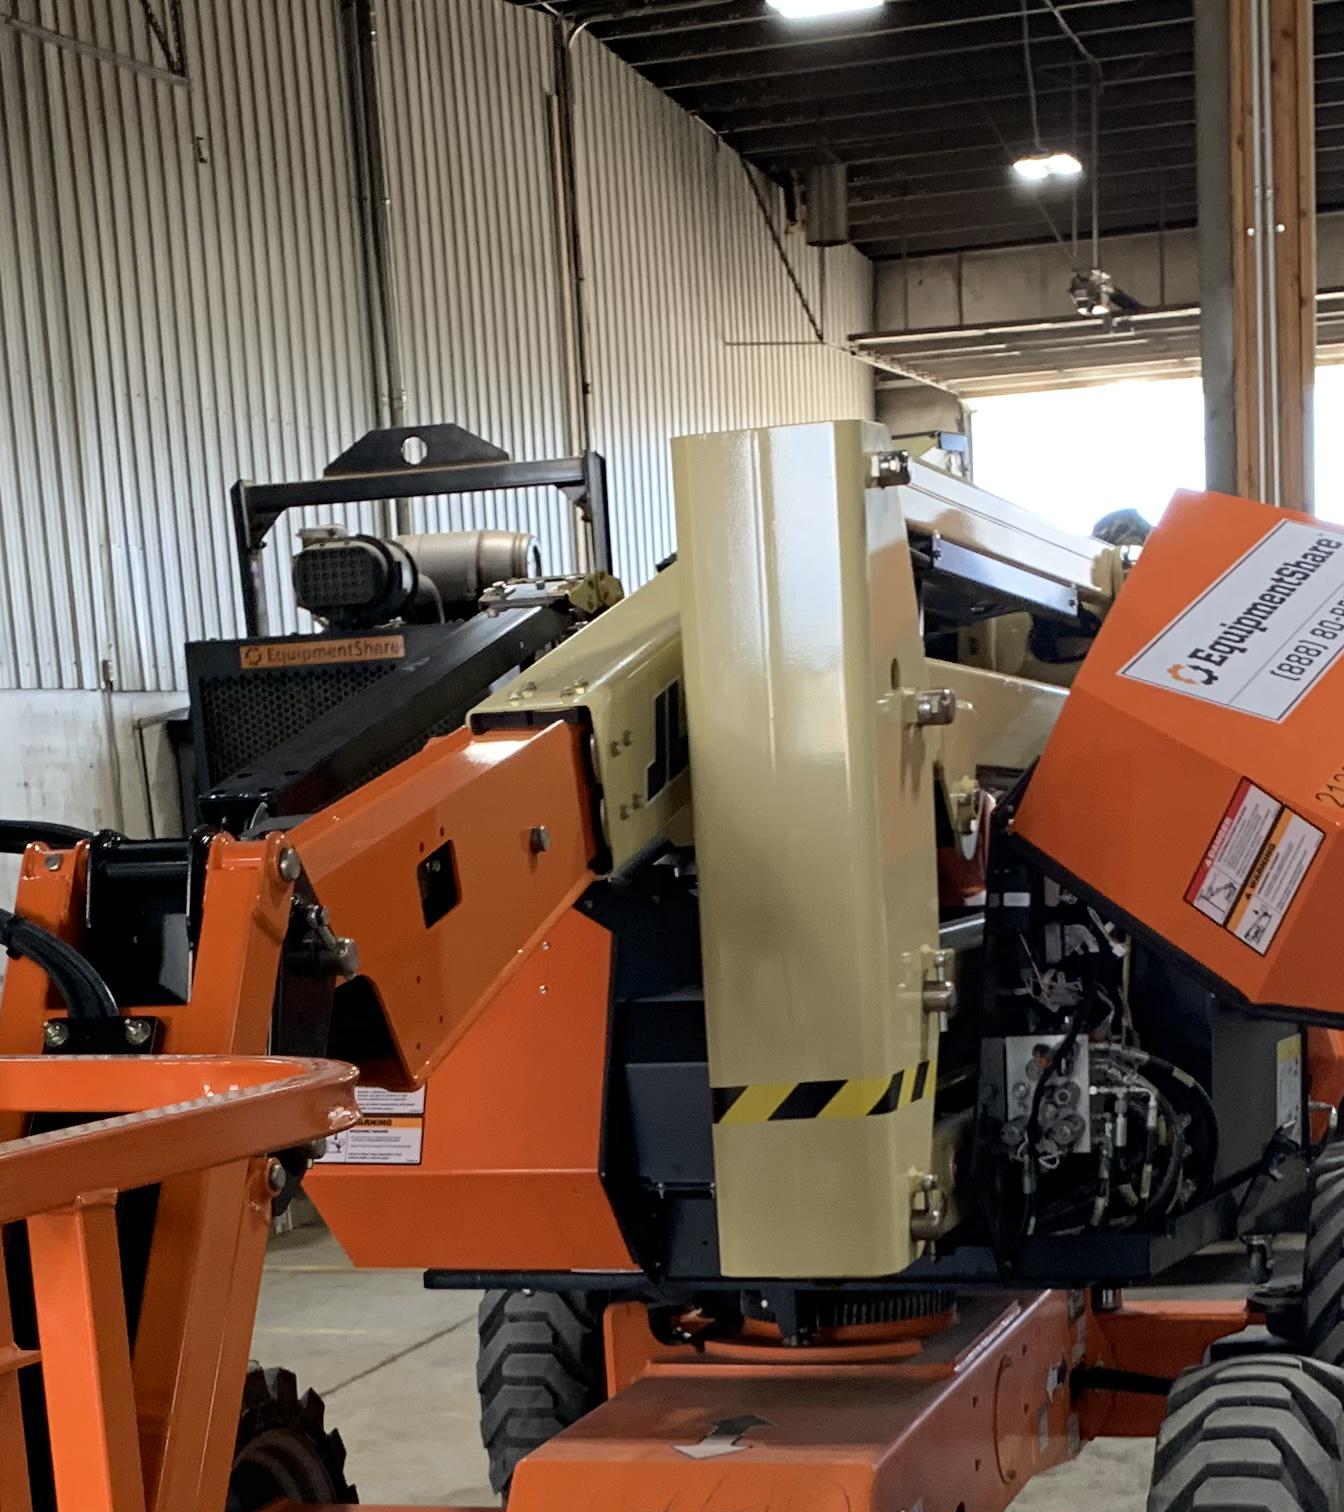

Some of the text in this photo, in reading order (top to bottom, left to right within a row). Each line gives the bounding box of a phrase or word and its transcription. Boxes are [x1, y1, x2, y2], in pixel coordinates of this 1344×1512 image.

[1187, 538, 1343, 667] EquipmentShare
[267, 641, 399, 663] EquipmentShare
[1270, 639, 1329, 681] (888)
[1250, 843, 1276, 889] WARNING
